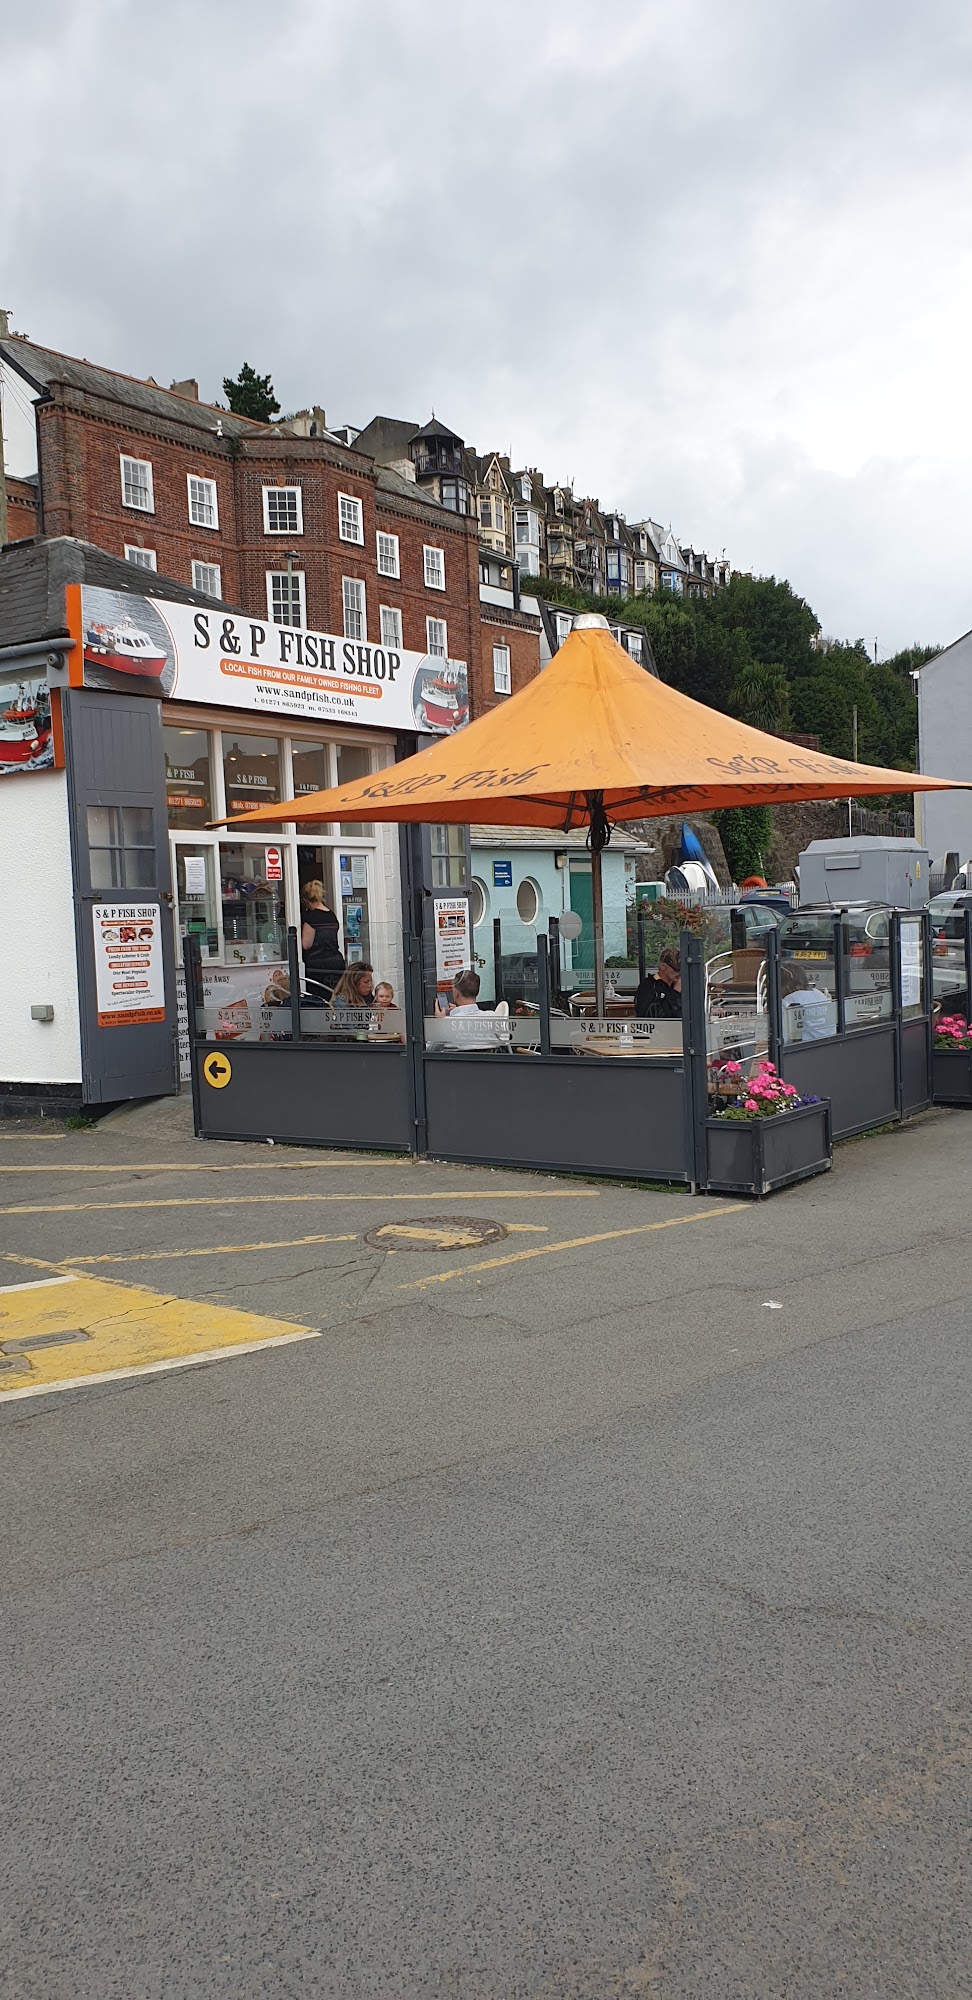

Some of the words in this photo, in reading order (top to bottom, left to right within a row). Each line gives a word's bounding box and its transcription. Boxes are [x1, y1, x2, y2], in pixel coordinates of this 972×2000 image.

[193, 613, 211, 649] S
[219, 619, 241, 655] &
[249, 624, 266, 657] P
[278, 630, 337, 672] FISH
[343, 643, 401, 681] SHOP
[224, 662, 247, 674] LOCAL
[247, 666, 263, 677] FISH
[263, 669, 282, 679] FROM
[282, 672, 296, 682] OUR
[296, 674, 318, 685] FAMILY
[318, 678, 340, 689] OWNED
[340, 681, 362, 693] FISHING
[362, 685, 379, 695] FLEET
[256, 685, 355, 707] www.sandpfish.co.uk
[260, 698, 280, 706] 01271
[166, 768, 173, 778] &
[173, 769, 179, 778] P
[180, 769, 195, 779] FISH
[236, 773, 241, 783] S
[242, 774, 248, 783] &
[248, 775, 253, 784] P
[253, 776, 267, 785] FISH
[446, 763, 552, 793] Fish
[96, 909, 101, 918] S
[102, 909, 109, 918] &
[111, 909, 116, 918] P
[118, 909, 136, 918] FISH
[137, 908, 157, 918] SHOP
[213, 974, 230, 983] Away
[325, 1012, 330, 1021] S
[340, 1012, 344, 1021] P
[346, 1012, 363, 1021] FISH
[451, 1020, 456, 1031] S
[458, 1021, 465, 1031] &
[467, 1021, 472, 1031] P
[474, 1021, 493, 1031] FISH
[495, 1021, 517, 1032] SHOP
[581, 1022, 586, 1032] S
[588, 1022, 596, 1033] &
[599, 1022, 604, 1033] P
[630, 1022, 655, 1034] SHOP
